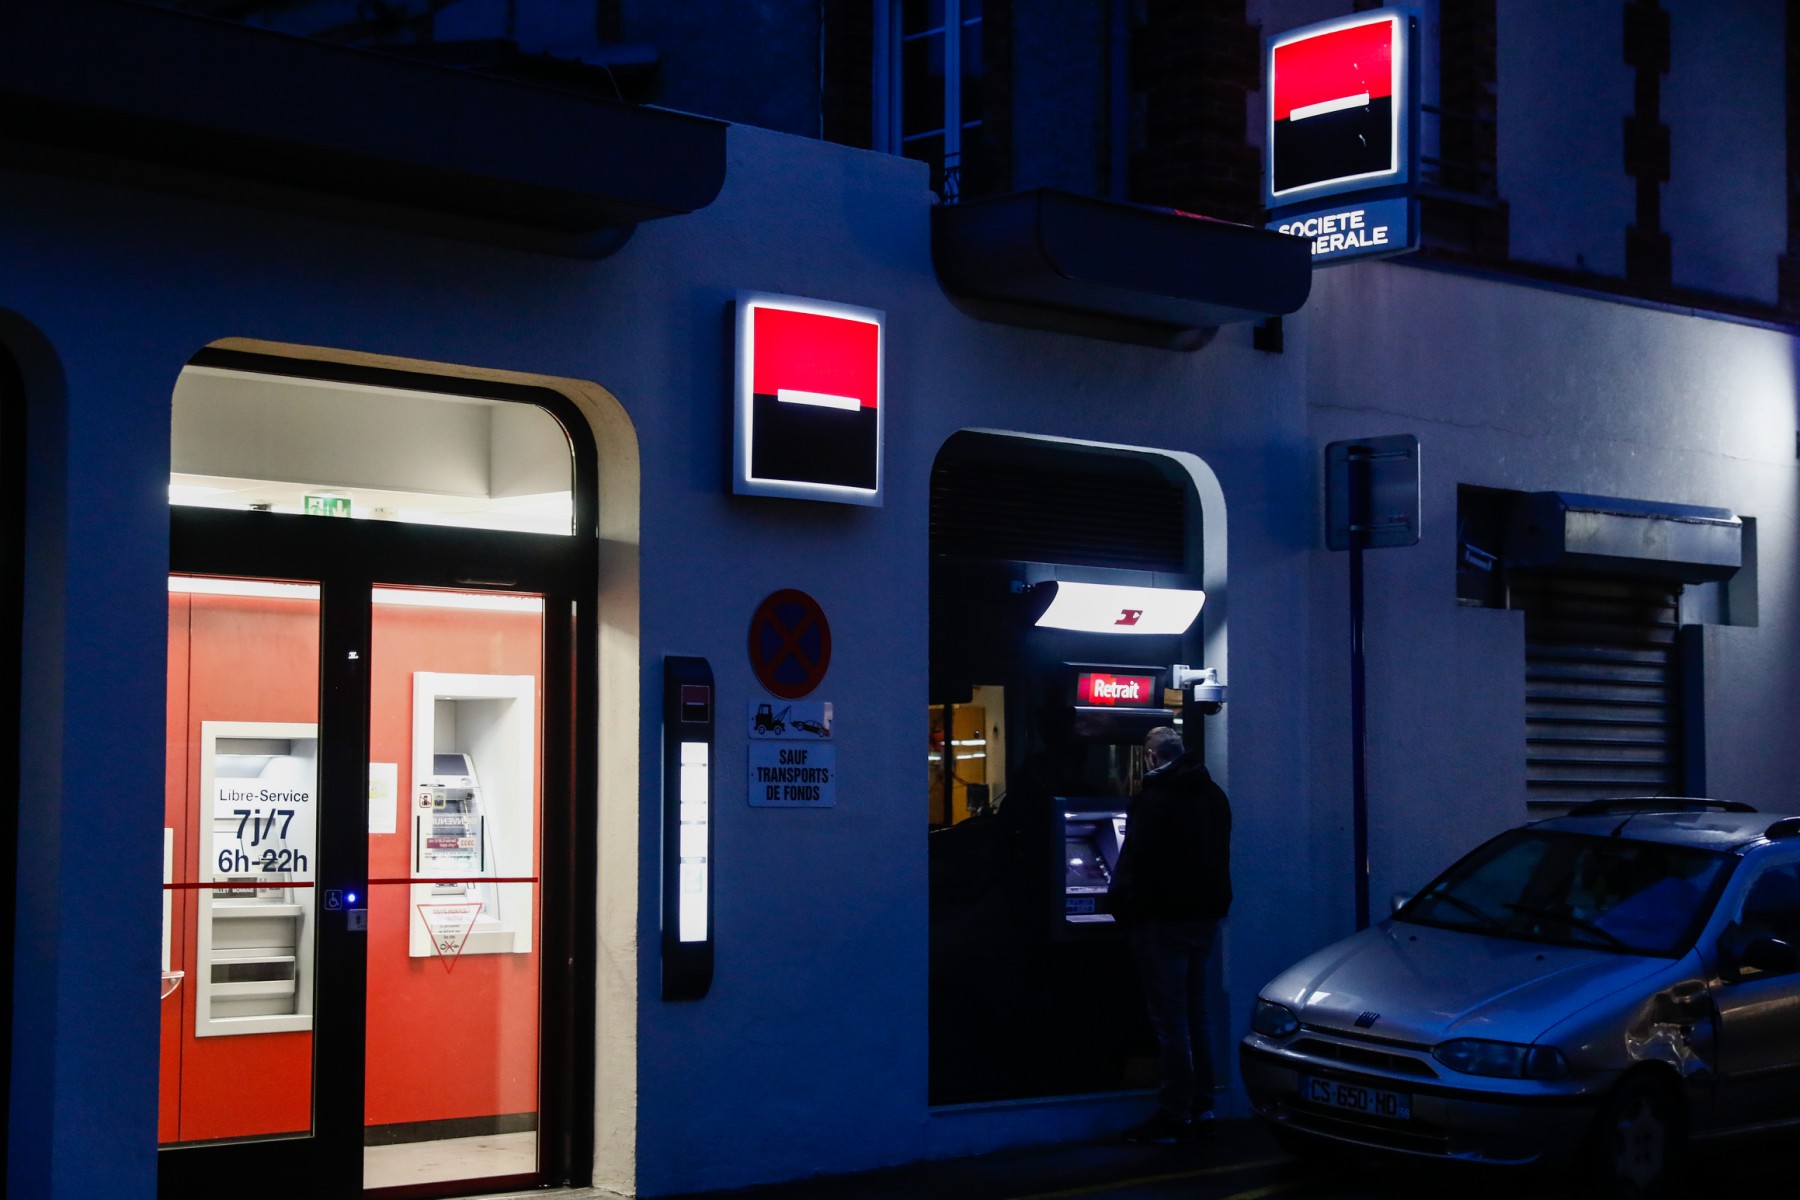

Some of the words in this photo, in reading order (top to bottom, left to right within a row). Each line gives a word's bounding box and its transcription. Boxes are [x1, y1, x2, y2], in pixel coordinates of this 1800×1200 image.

[1094, 679, 1139, 699] Retrait
[779, 749, 808, 765] SAUF
[757, 767, 829, 783] TRANSPORTS
[220, 789, 309, 802] Libre-Service
[766, 785, 780, 801] DE
[784, 785, 820, 801] FONDS
[233, 808, 295, 846] 7j/7
[218, 849, 307, 873] 6h-22h
[1400, 1108, 1411, 1119] 56
